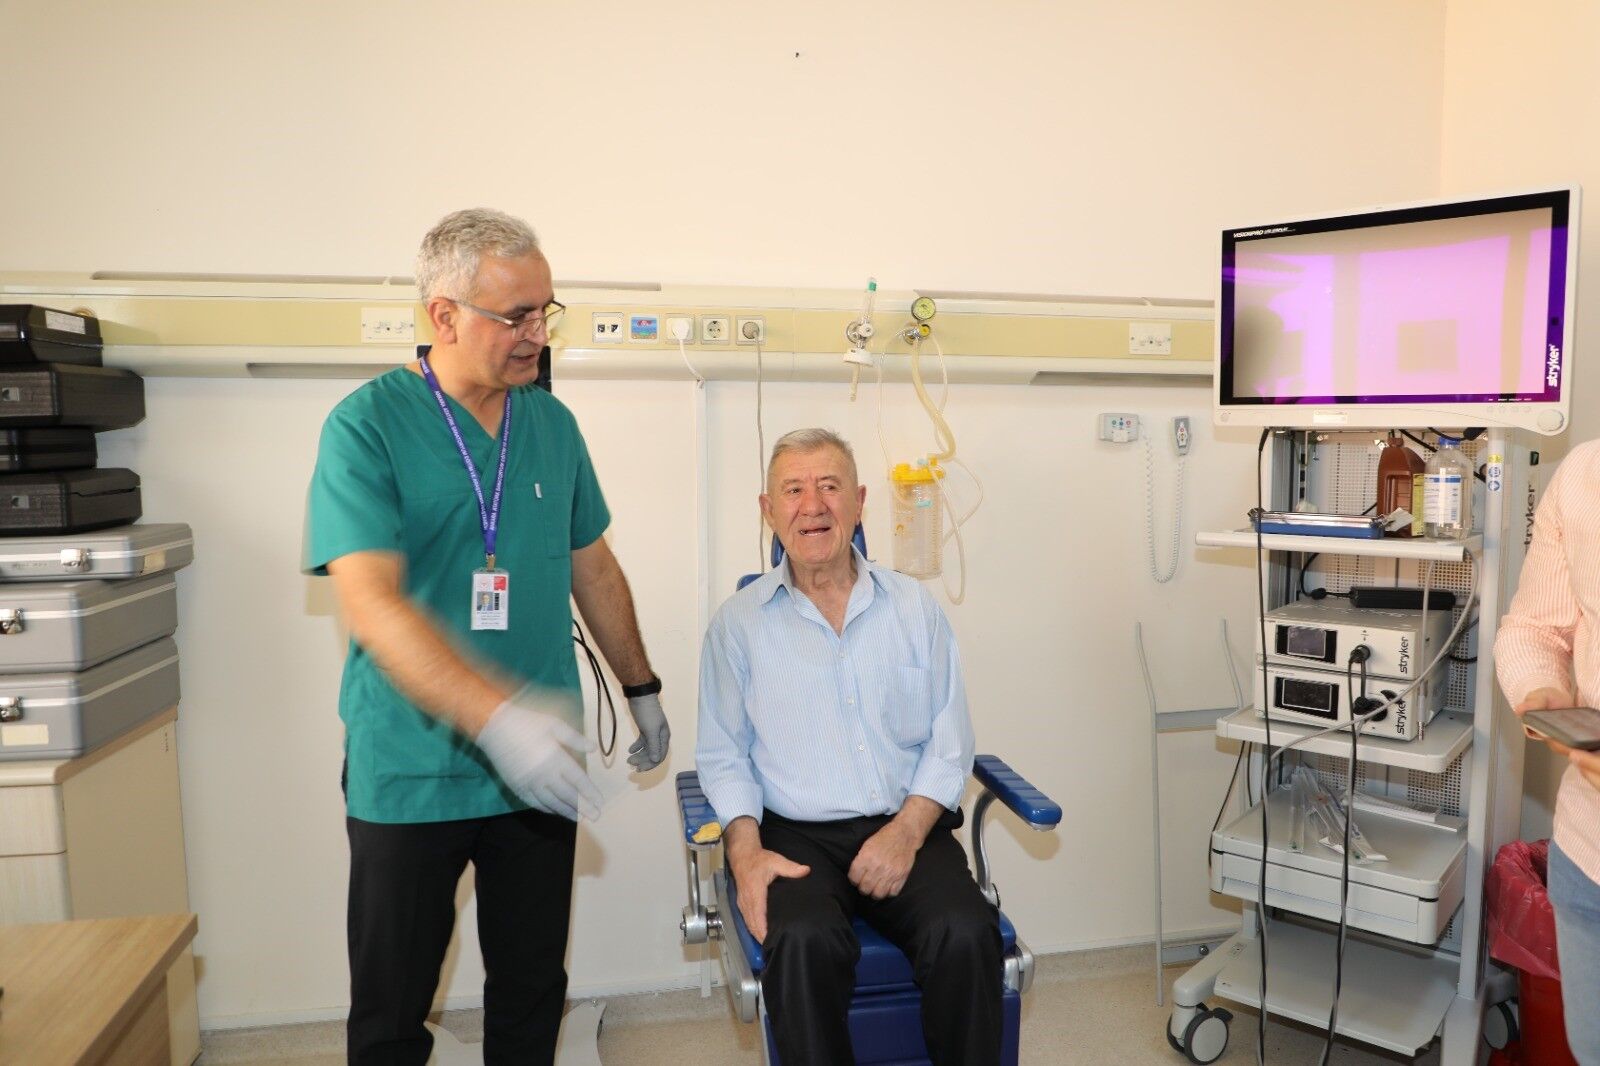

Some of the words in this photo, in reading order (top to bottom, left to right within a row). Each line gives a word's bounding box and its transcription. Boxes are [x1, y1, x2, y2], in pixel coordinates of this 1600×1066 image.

[1546, 344, 1560, 387] stryker
[435, 391, 446, 407] ANKARA
[1524, 484, 1536, 557] tryker
[1398, 636, 1409, 674] stryker
